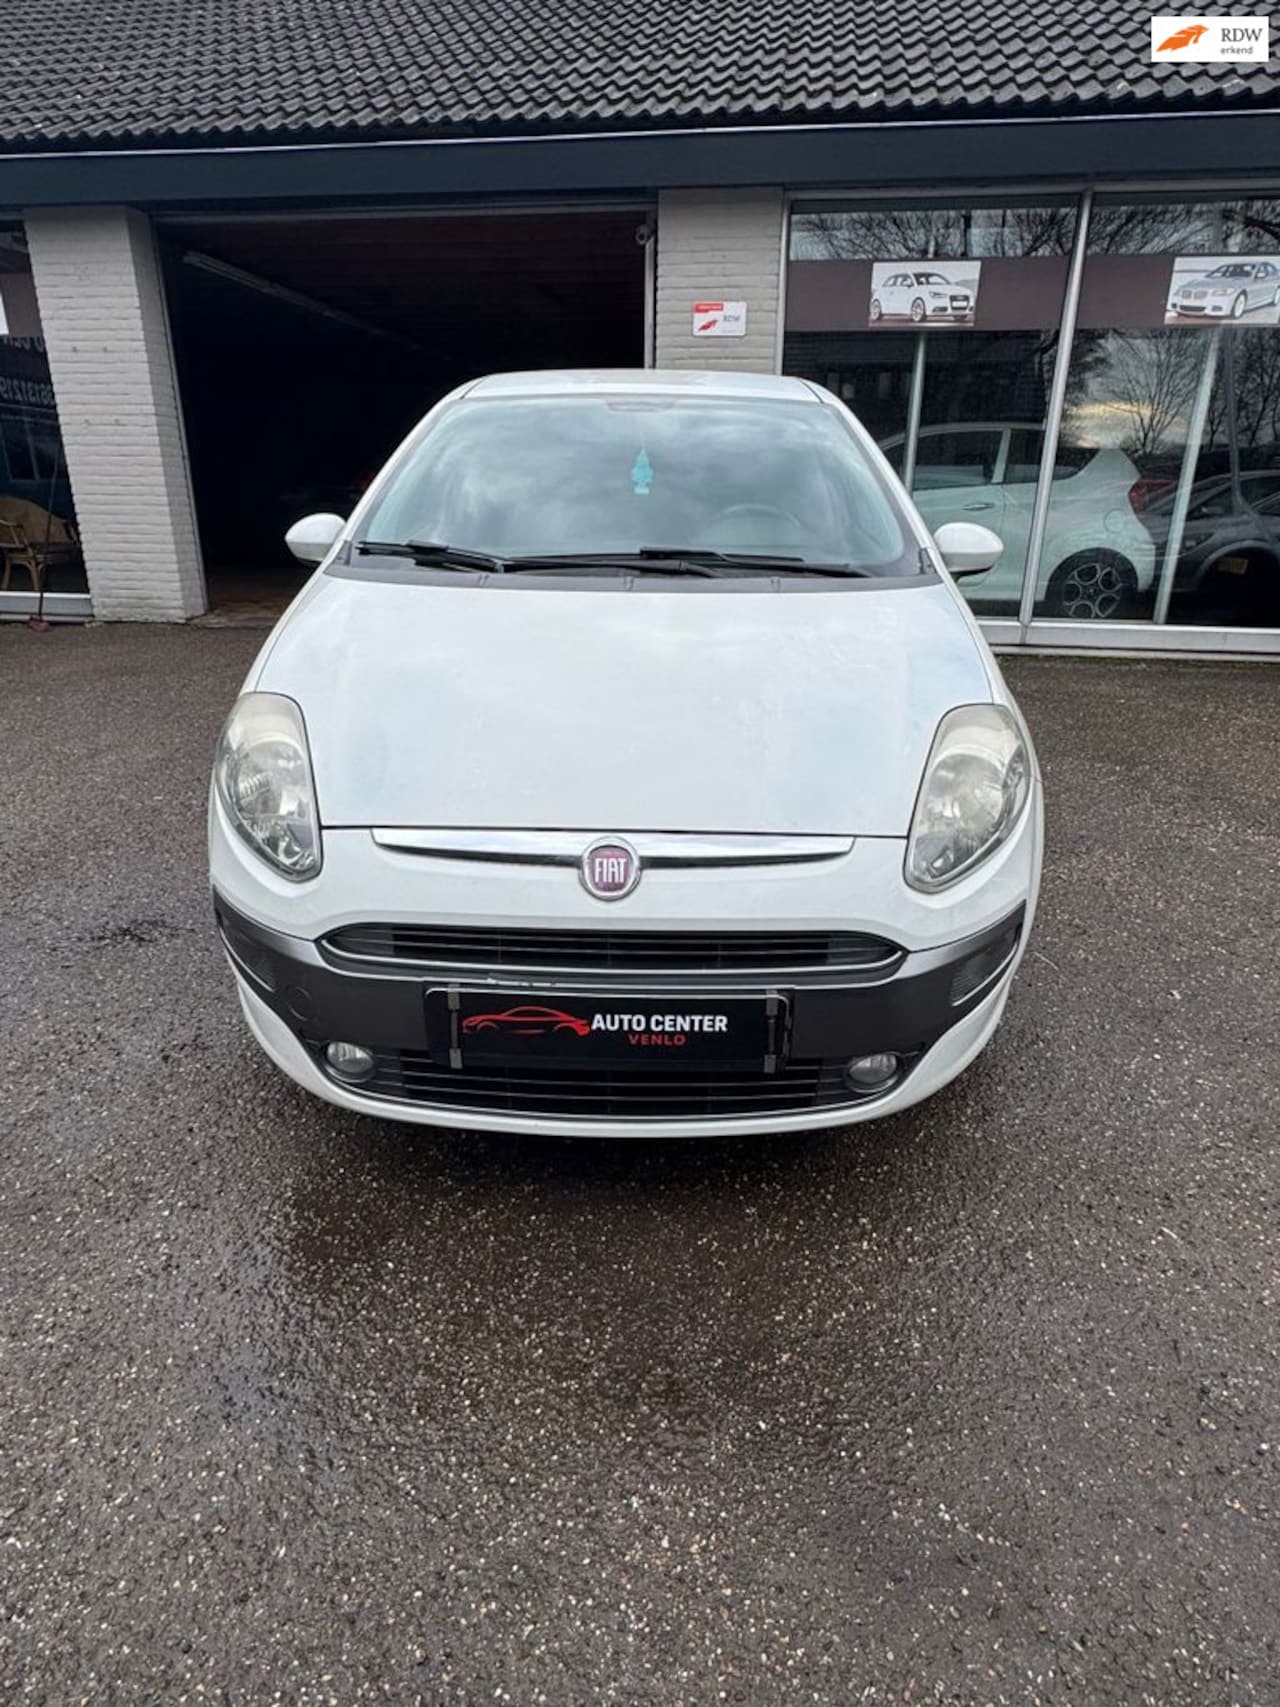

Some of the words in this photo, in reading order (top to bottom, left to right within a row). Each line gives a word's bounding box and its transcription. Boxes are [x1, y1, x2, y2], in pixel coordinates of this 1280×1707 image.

[594, 857, 627, 883] FIAT
[591, 1013, 646, 1031] AUTO
[650, 1014, 728, 1033] CENTER
[629, 1034, 686, 1046] VENLO
